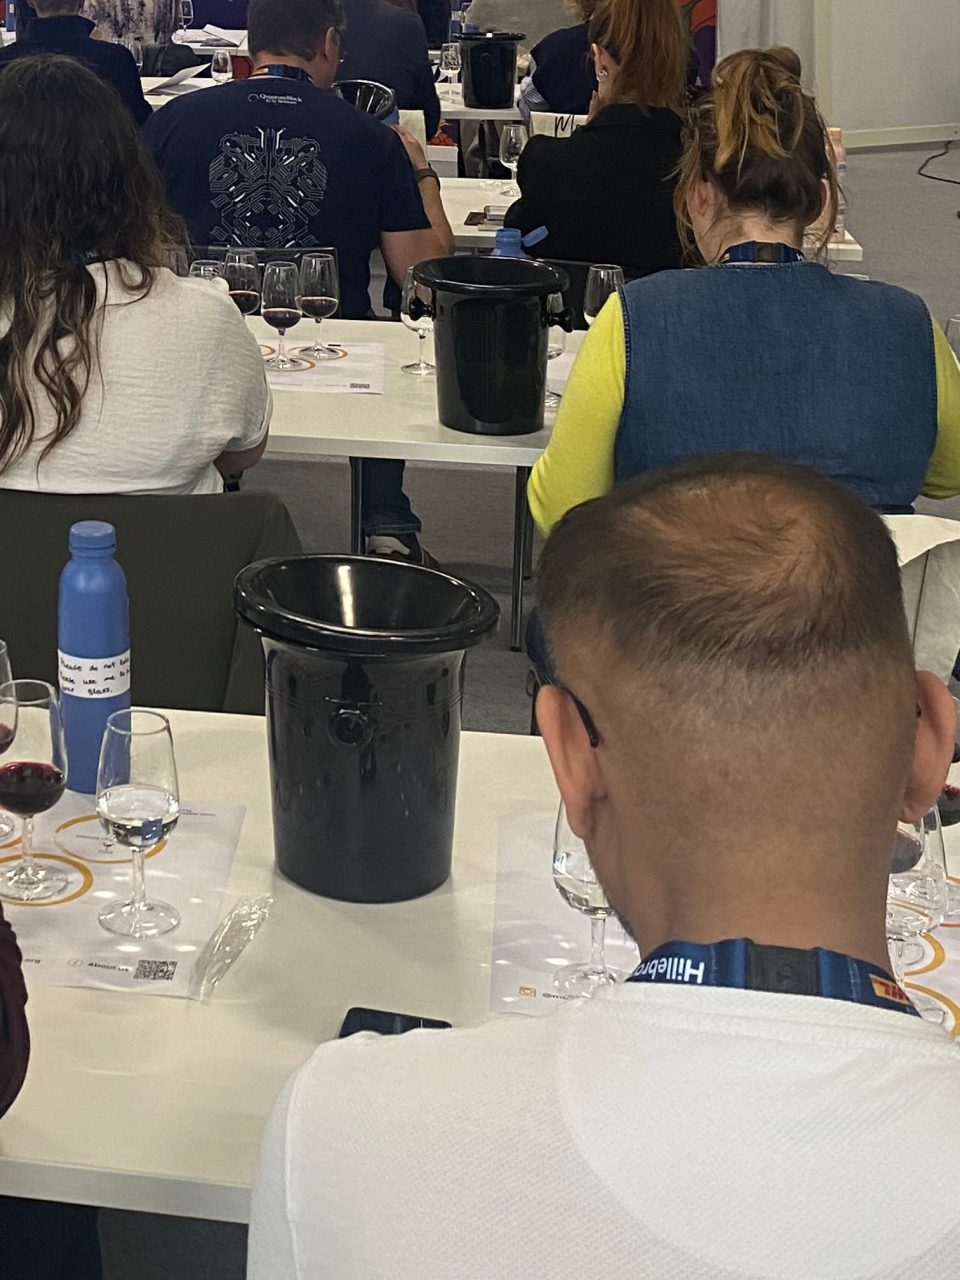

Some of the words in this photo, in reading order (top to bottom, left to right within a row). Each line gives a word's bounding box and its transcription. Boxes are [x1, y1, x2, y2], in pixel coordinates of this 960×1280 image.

[60, 657, 82, 671] Please
[104, 661, 116, 669] not
[87, 961, 117, 970] About
